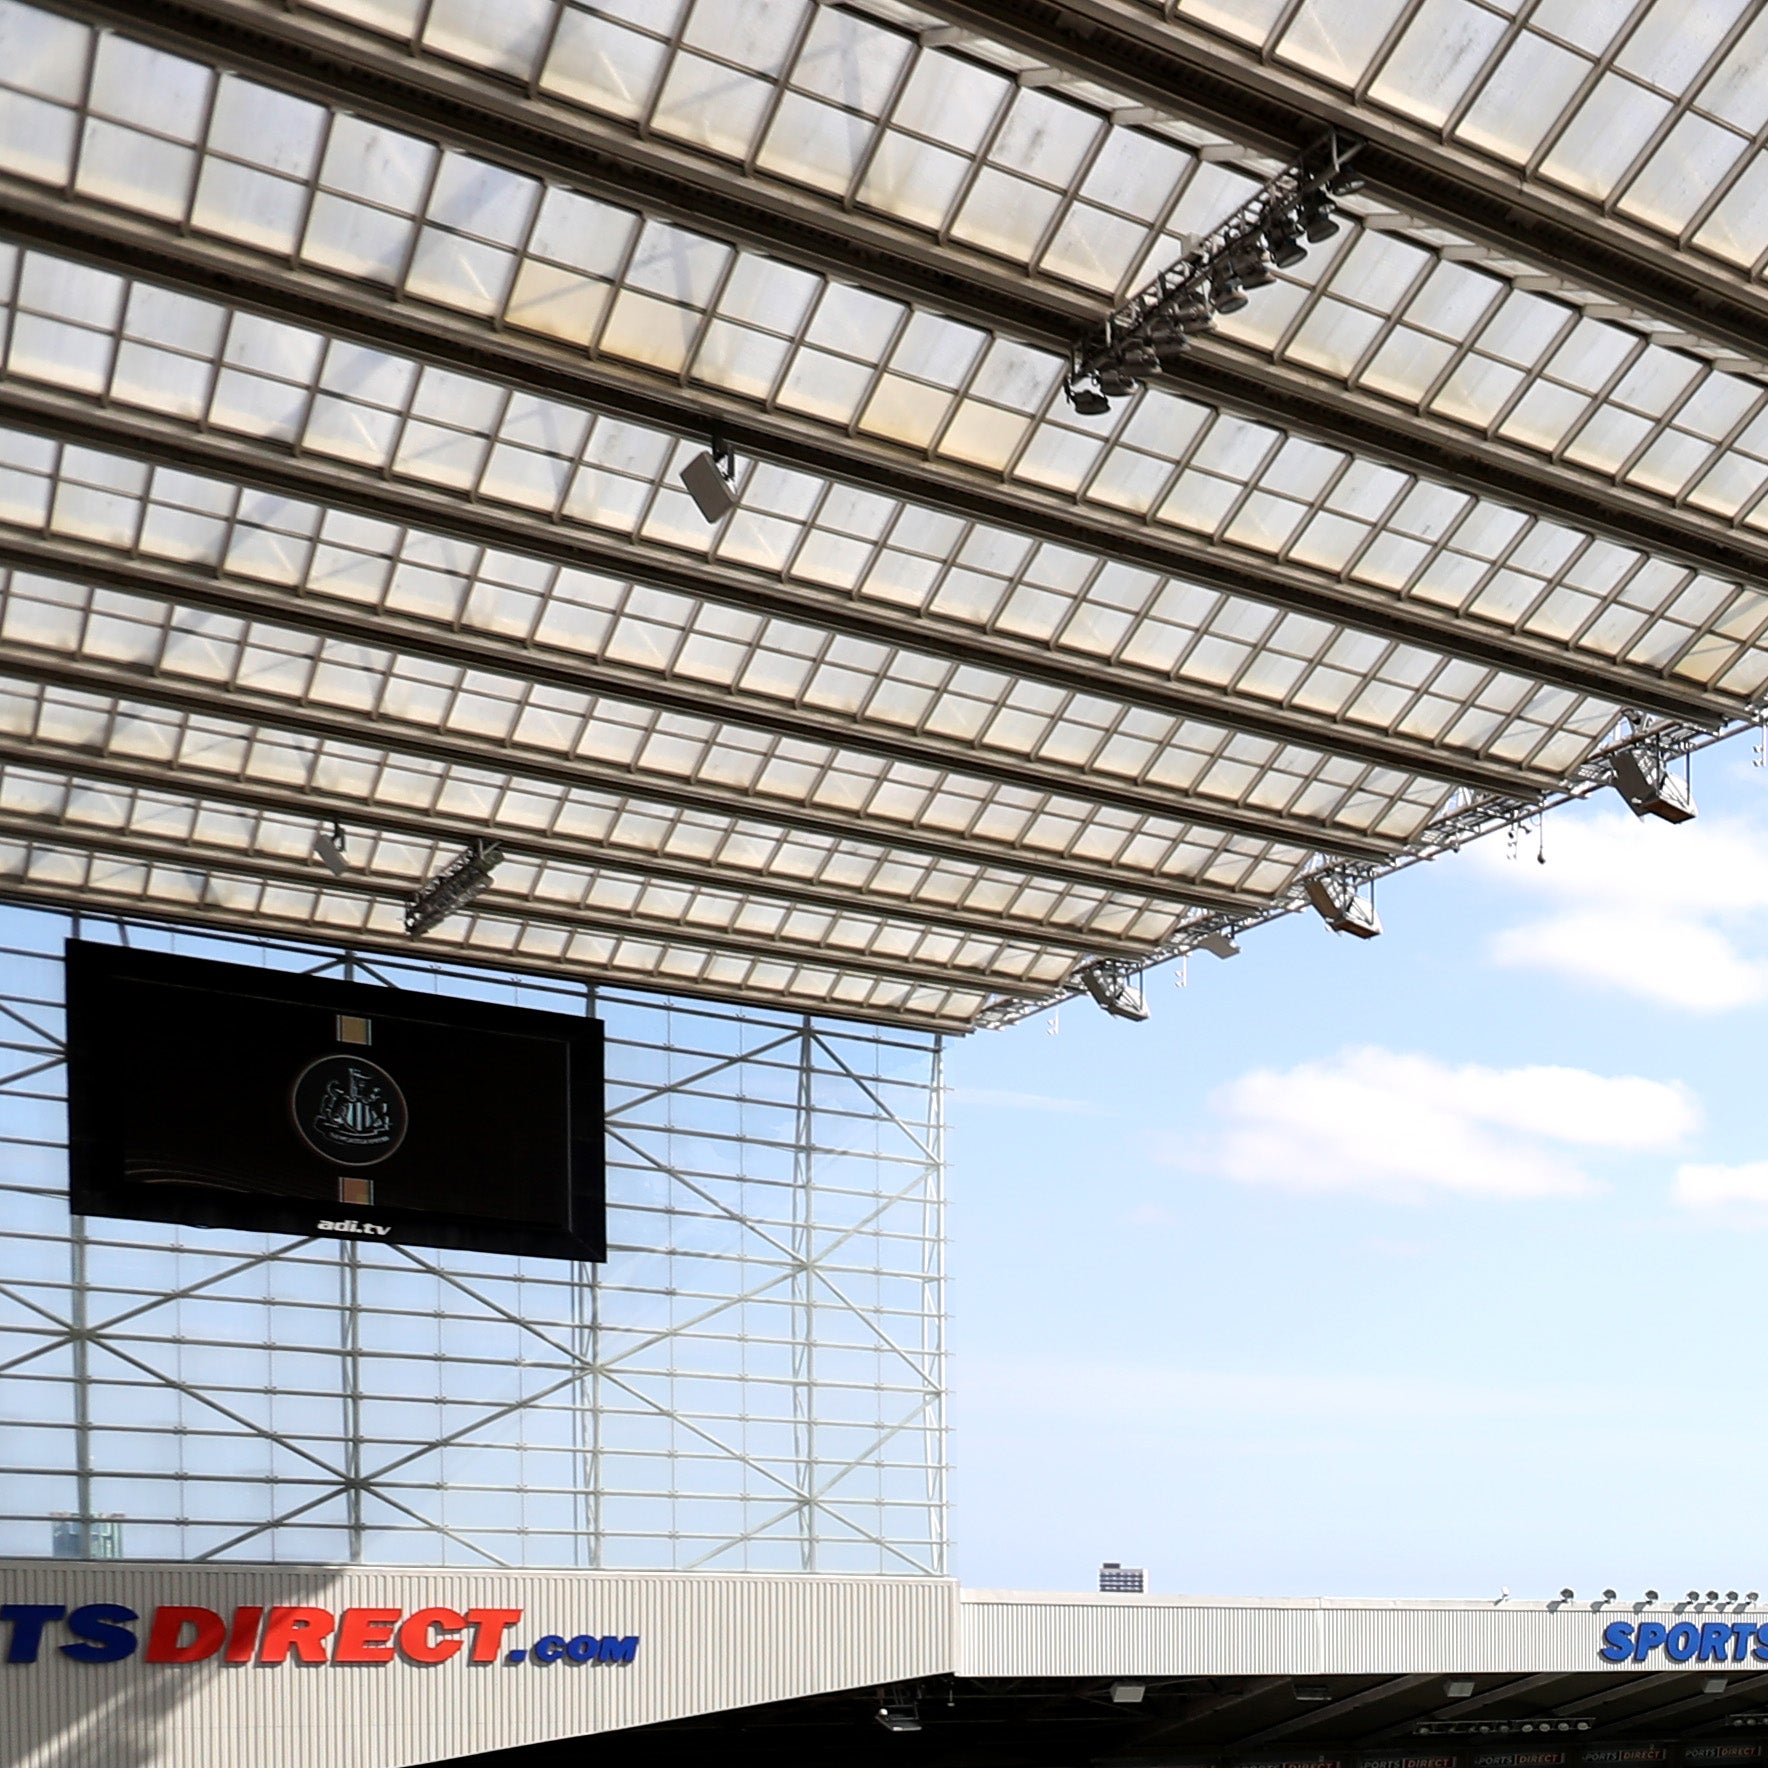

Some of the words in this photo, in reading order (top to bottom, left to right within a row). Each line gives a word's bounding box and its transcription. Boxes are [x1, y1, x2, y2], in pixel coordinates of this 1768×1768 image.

[317, 1219, 392, 1236] adi.tv
[1621, 1750, 1664, 1761] DIRECT
[1720, 1746, 1759, 1757] DIRECT
[1405, 1758, 1454, 1768] DIRECT
[1517, 1753, 1562, 1765] DIRECT
